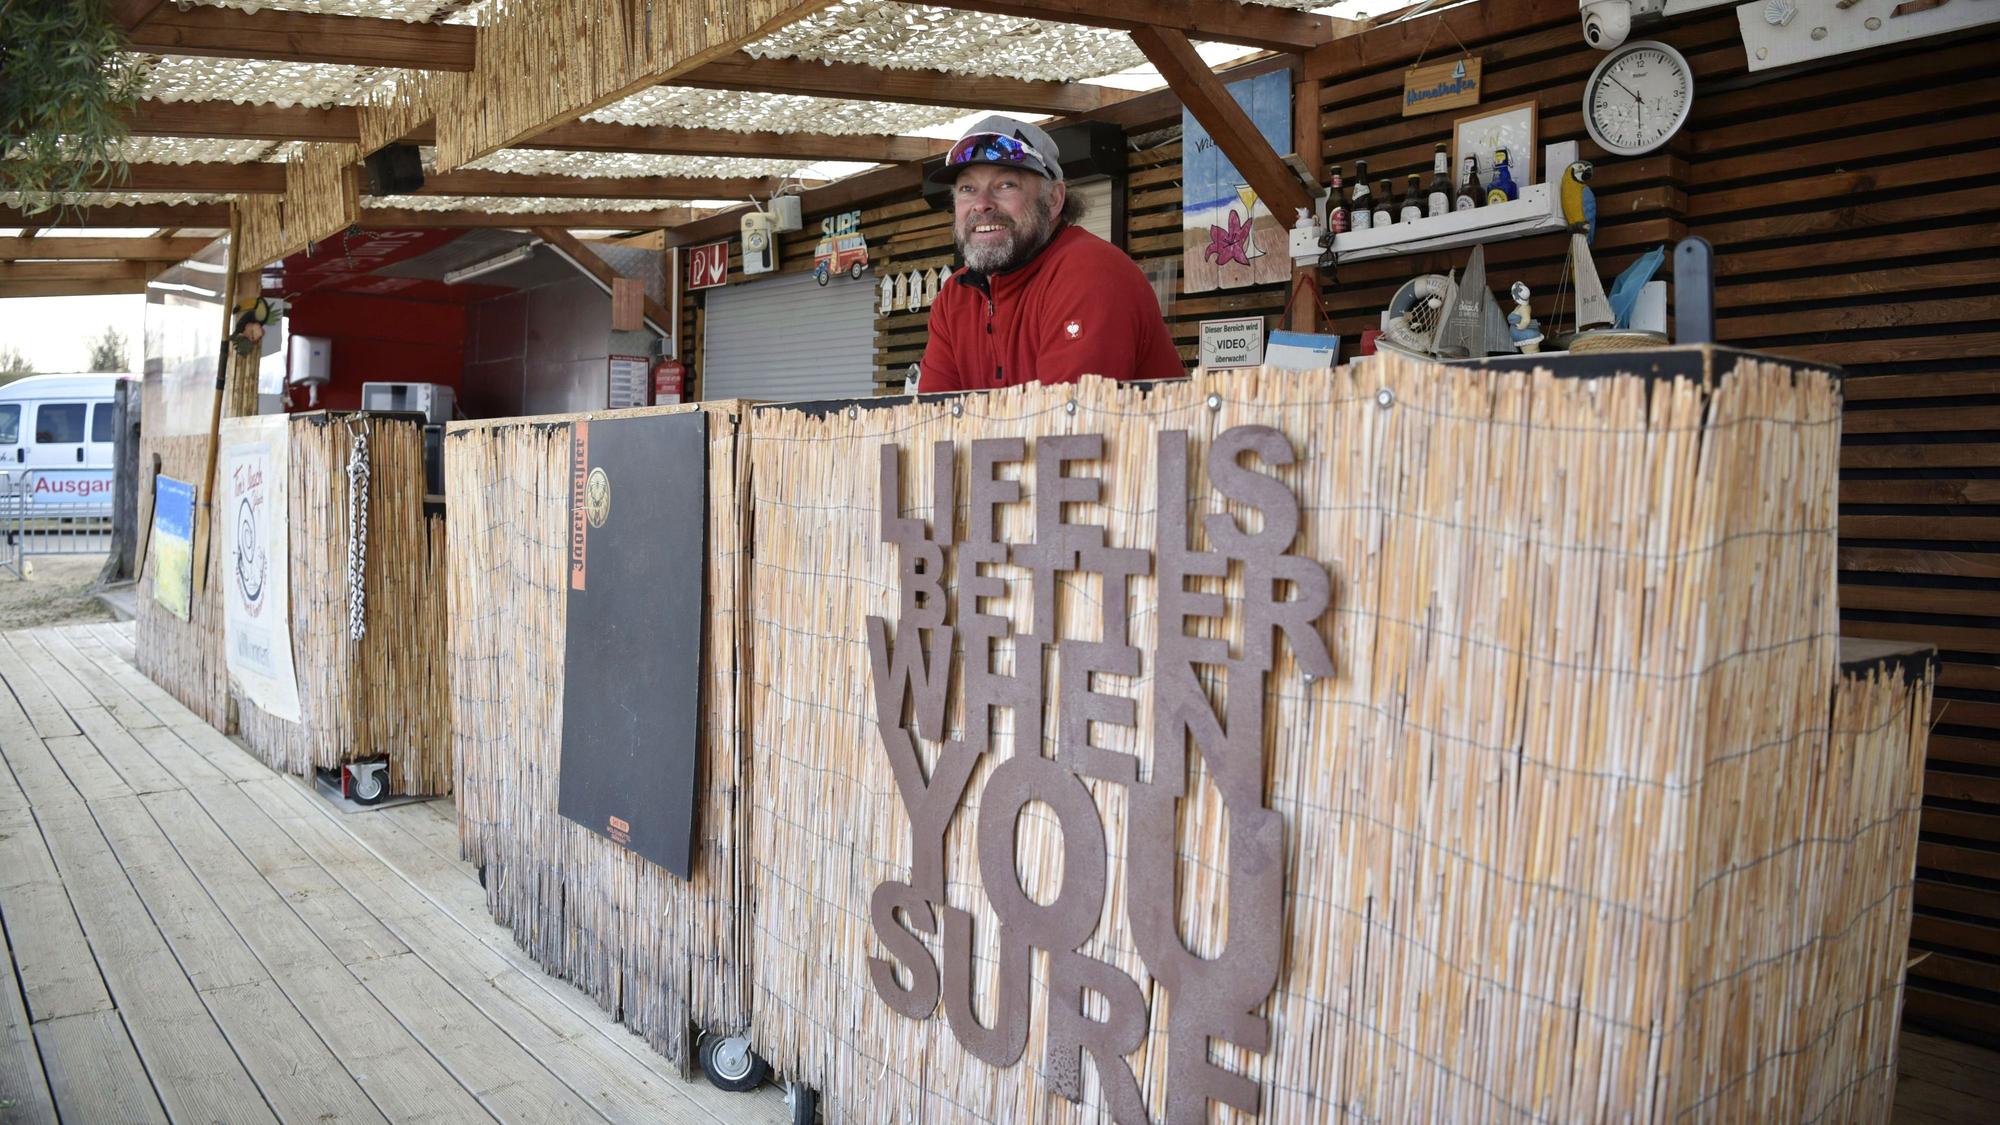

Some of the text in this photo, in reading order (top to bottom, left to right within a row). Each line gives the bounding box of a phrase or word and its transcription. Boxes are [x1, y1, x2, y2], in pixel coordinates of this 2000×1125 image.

[1636, 60, 1645, 68] 12
[1673, 89, 1679, 98] 3
[1602, 101, 1608, 109] 9
[1636, 131, 1642, 139] 6
[821, 210, 861, 238] SURF
[883, 283, 936, 308] BEAC
[1205, 325, 1222, 334] Dieser
[1224, 324, 1244, 332] Bereich
[1217, 338, 1246, 349] VIDEO
[1215, 354, 1247, 363] überwacht!
[881, 424, 1300, 556] LIFE IS
[900, 538, 1335, 677] BETTER
[866, 613, 1273, 808] WHEN
[874, 722, 1283, 1012] YOU
[868, 879, 1269, 1125] SURF
